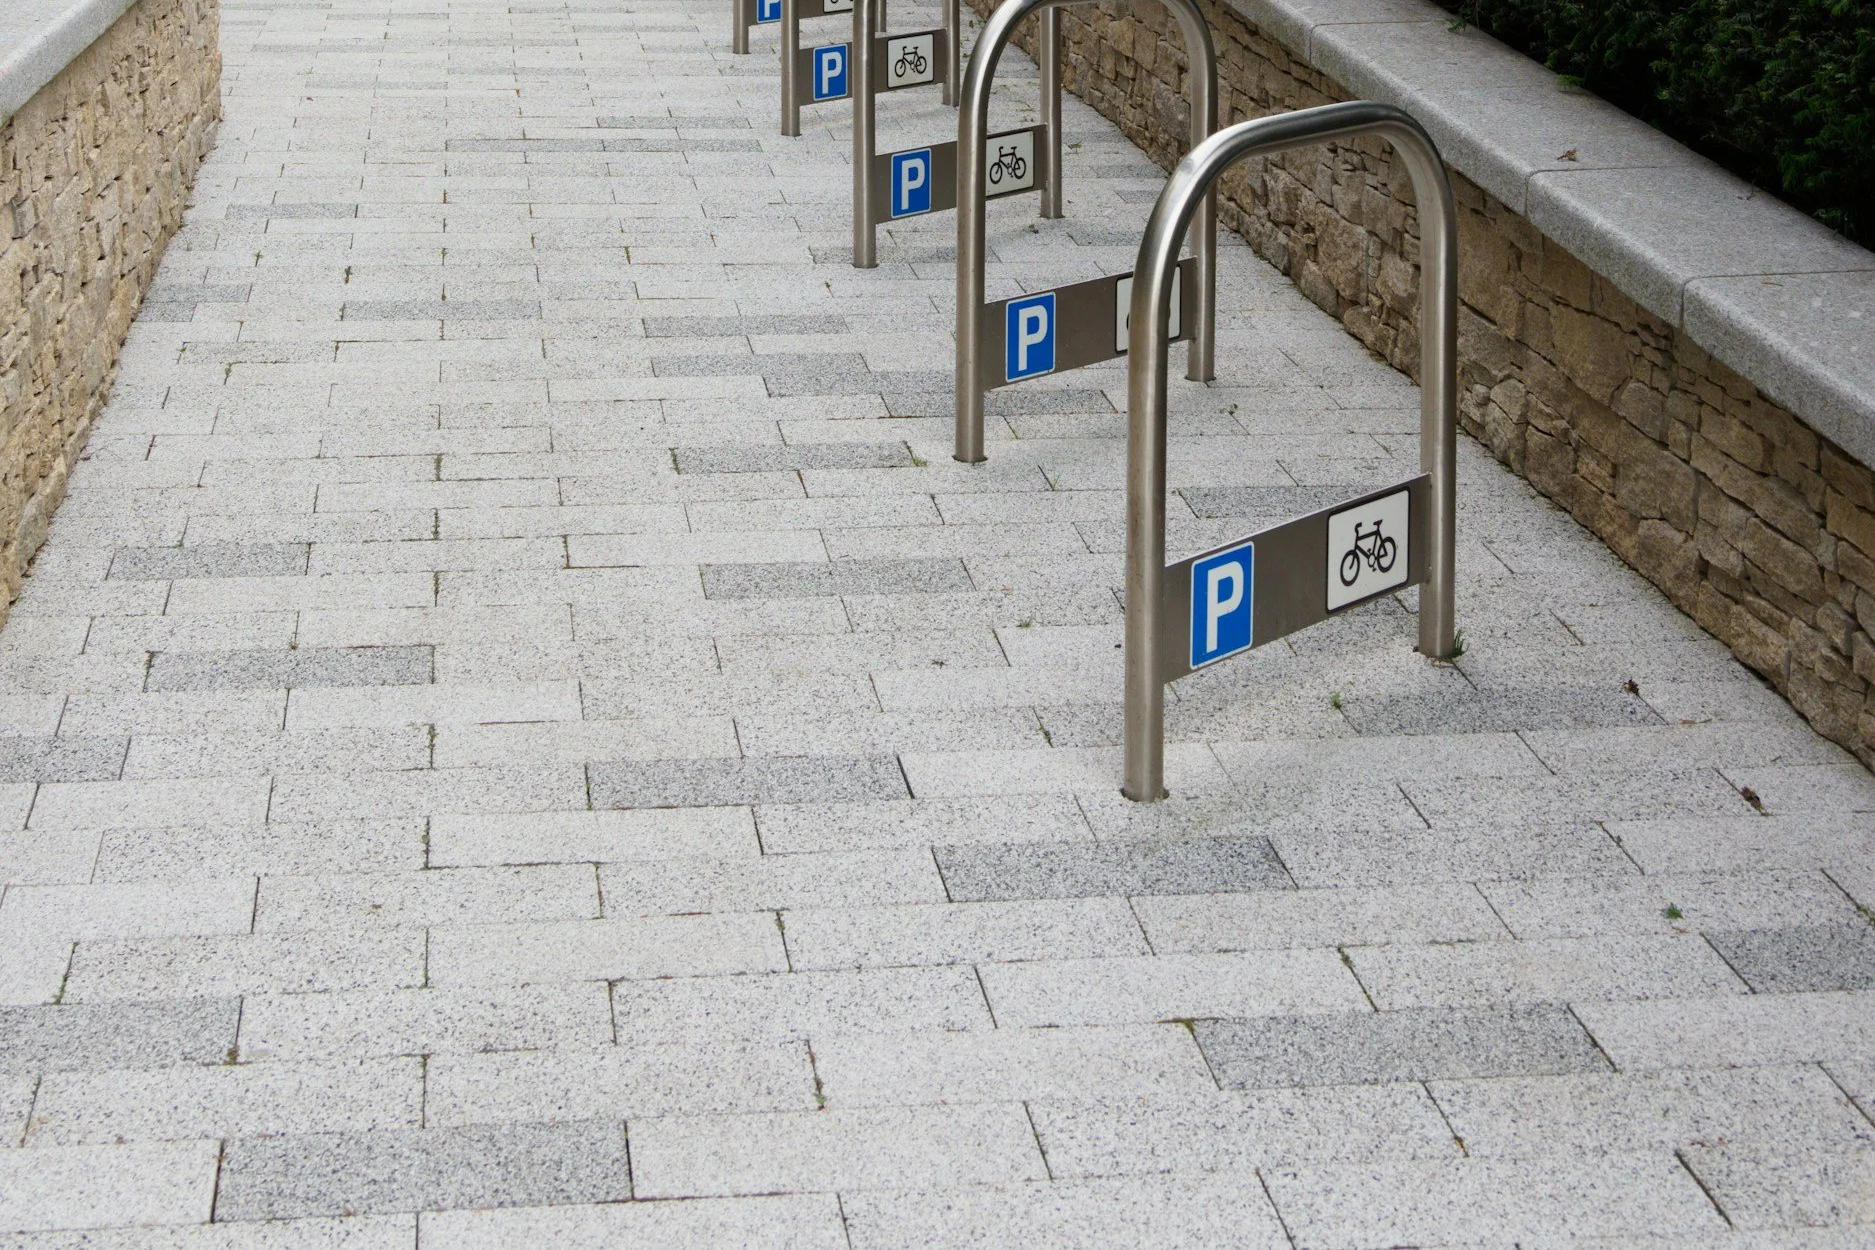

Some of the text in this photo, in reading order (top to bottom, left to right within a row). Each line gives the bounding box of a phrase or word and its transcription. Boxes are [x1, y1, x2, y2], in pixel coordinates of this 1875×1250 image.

[822, 52, 842, 94] P
[901, 158, 925, 210] P
[1018, 305, 1048, 371] P
[1206, 561, 1244, 653] P
